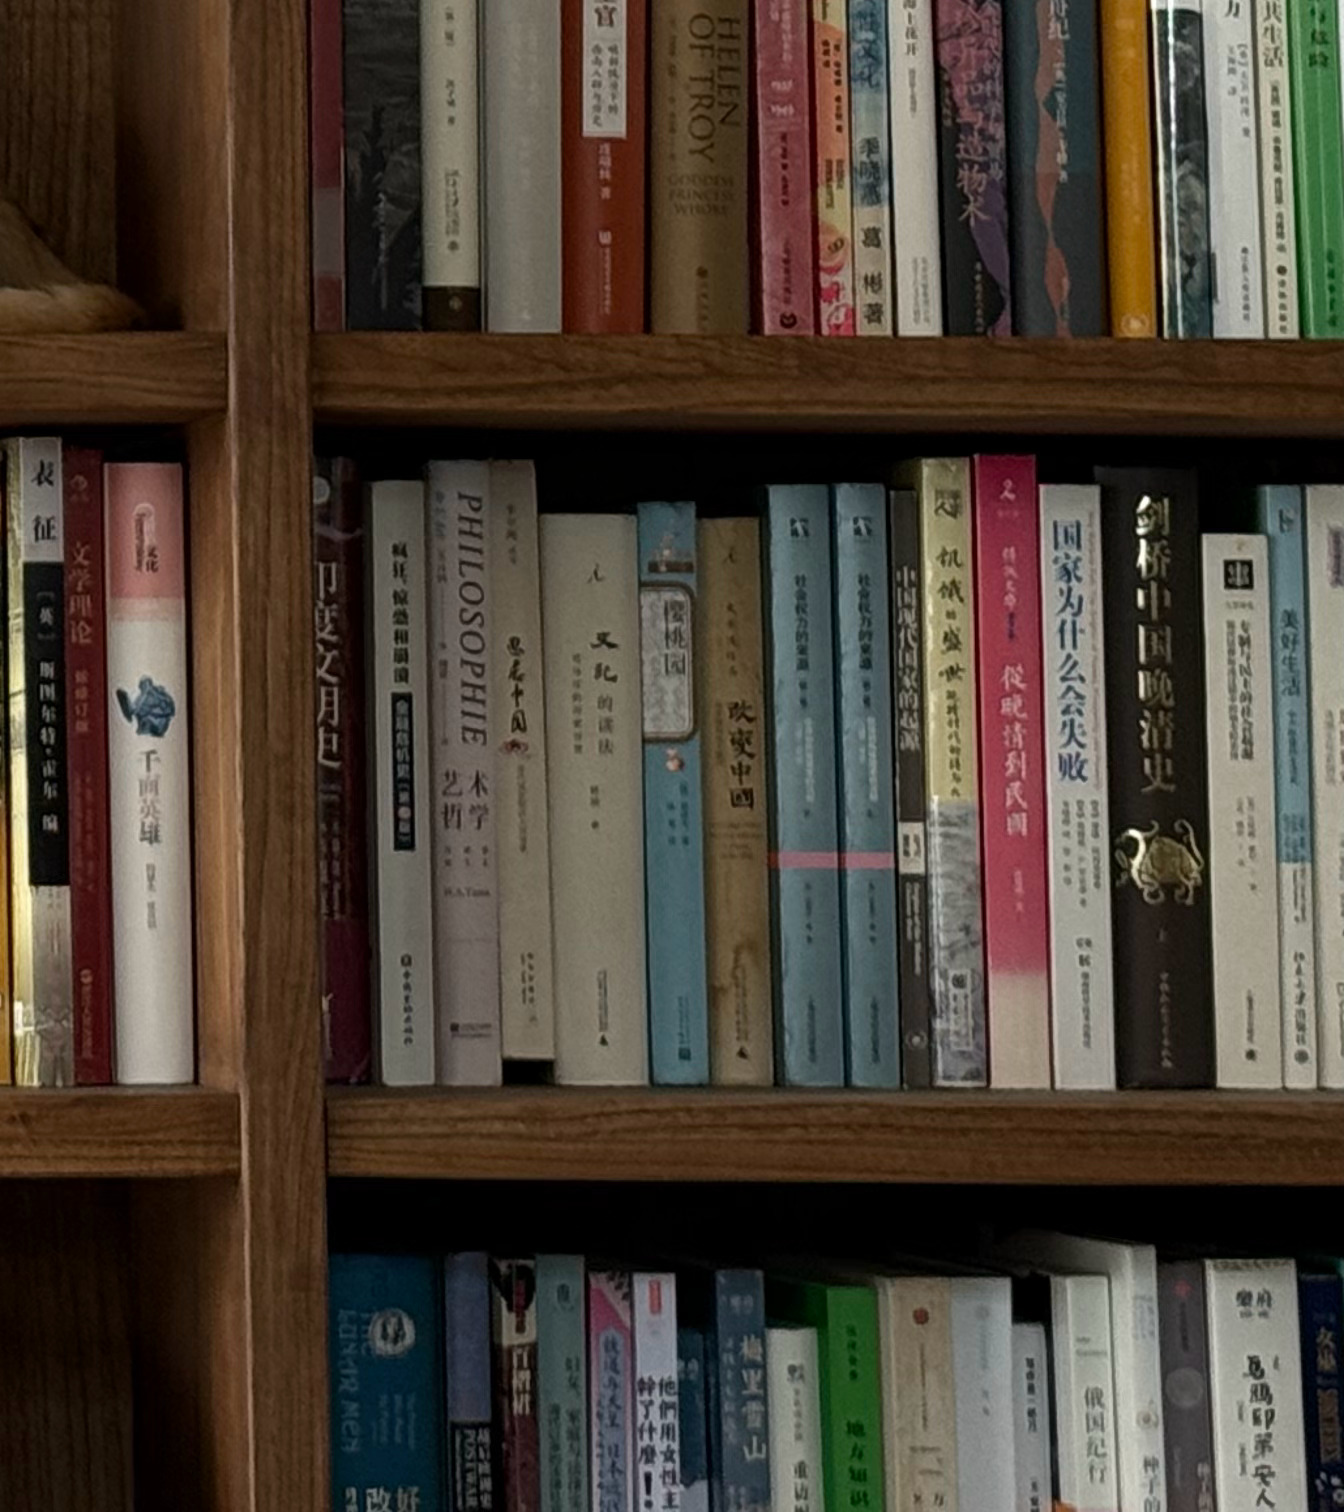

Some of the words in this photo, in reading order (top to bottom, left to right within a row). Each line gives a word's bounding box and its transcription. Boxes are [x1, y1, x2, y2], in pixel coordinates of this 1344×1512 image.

[689, 14, 715, 57] OF
[716, 18, 741, 127] HELEN
[689, 67, 716, 162] TROY
[31, 459, 56, 541] 表征
[69, 542, 94, 645] 文学理论
[457, 492, 488, 748] PHILOSOPHIE
[1051, 519, 1089, 784] 国家为什么会失败
[137, 750, 162, 846] 千面英雄
